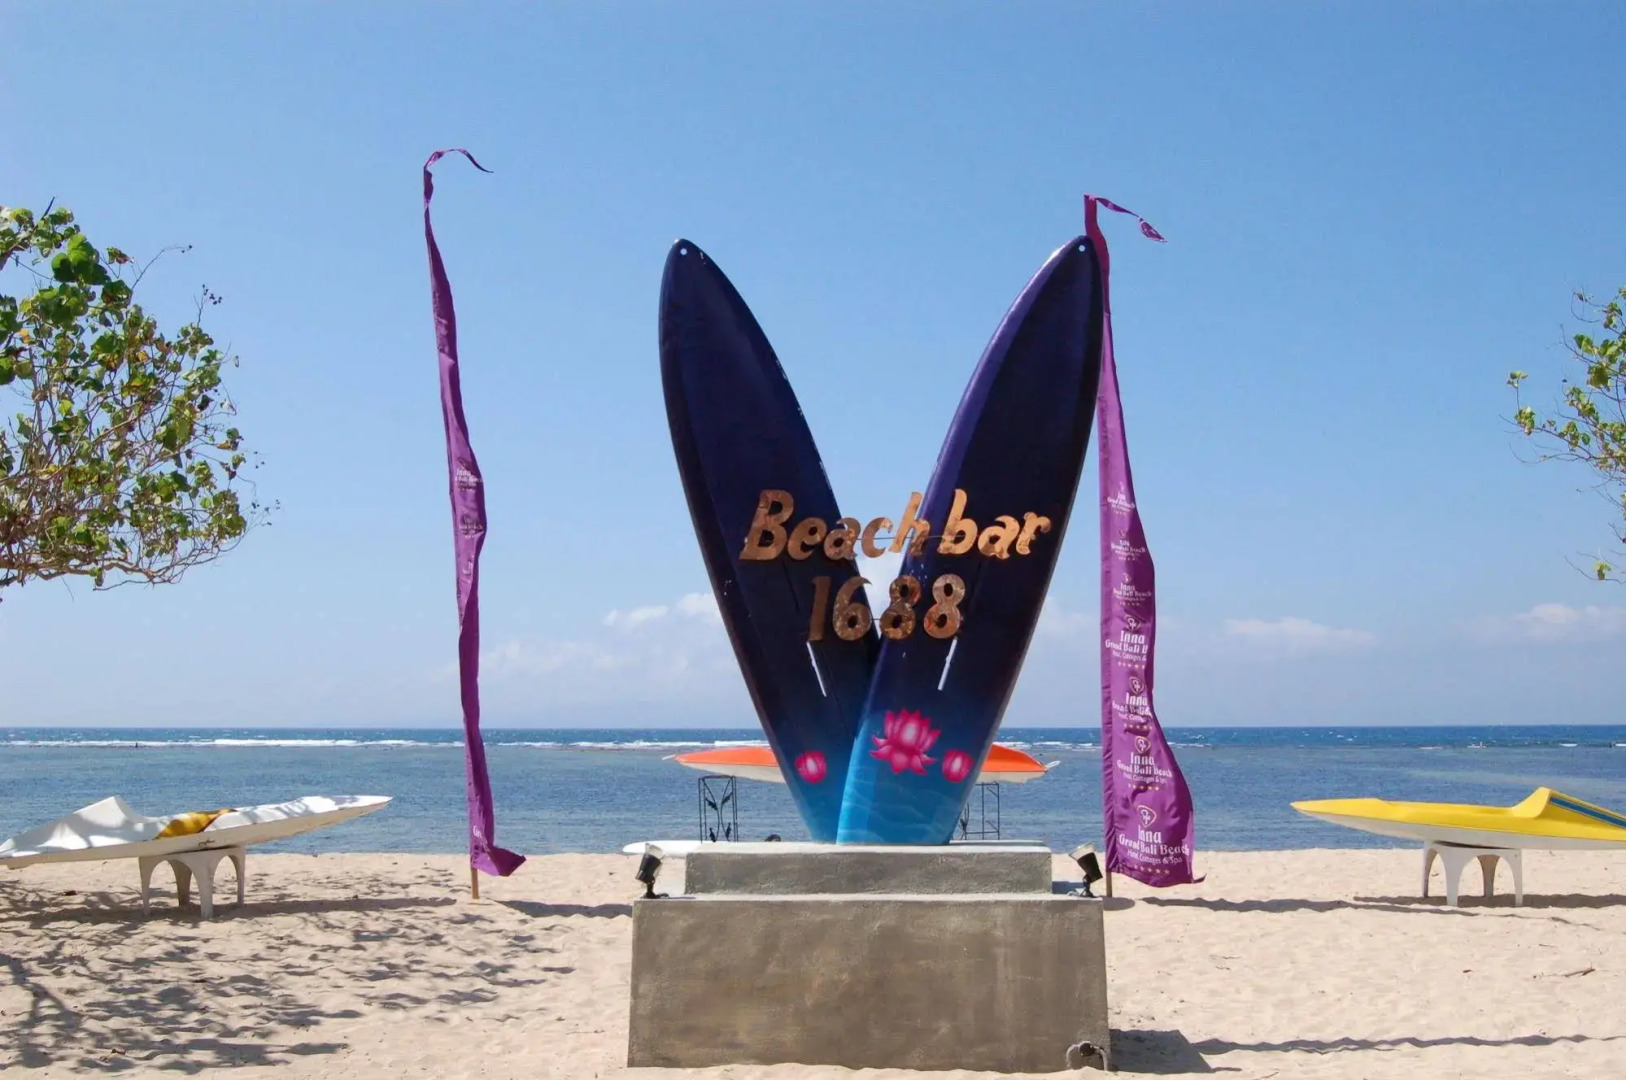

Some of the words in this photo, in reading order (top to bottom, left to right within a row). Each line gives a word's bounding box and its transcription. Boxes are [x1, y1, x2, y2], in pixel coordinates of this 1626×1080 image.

[739, 489, 931, 561] Beach
[936, 488, 1052, 561] bar
[807, 573, 966, 642] 1688
[1120, 630, 1146, 644] Inna
[1123, 643, 1140, 653] Bali
[1125, 692, 1148, 706] Inna
[1130, 752, 1155, 766] Inna
[1134, 764, 1152, 775] Bali
[1138, 824, 1162, 844] Inna
[1119, 833, 1140, 850] Grand
[1140, 842, 1157, 856] Bali
[1159, 843, 1190, 856] Beach
